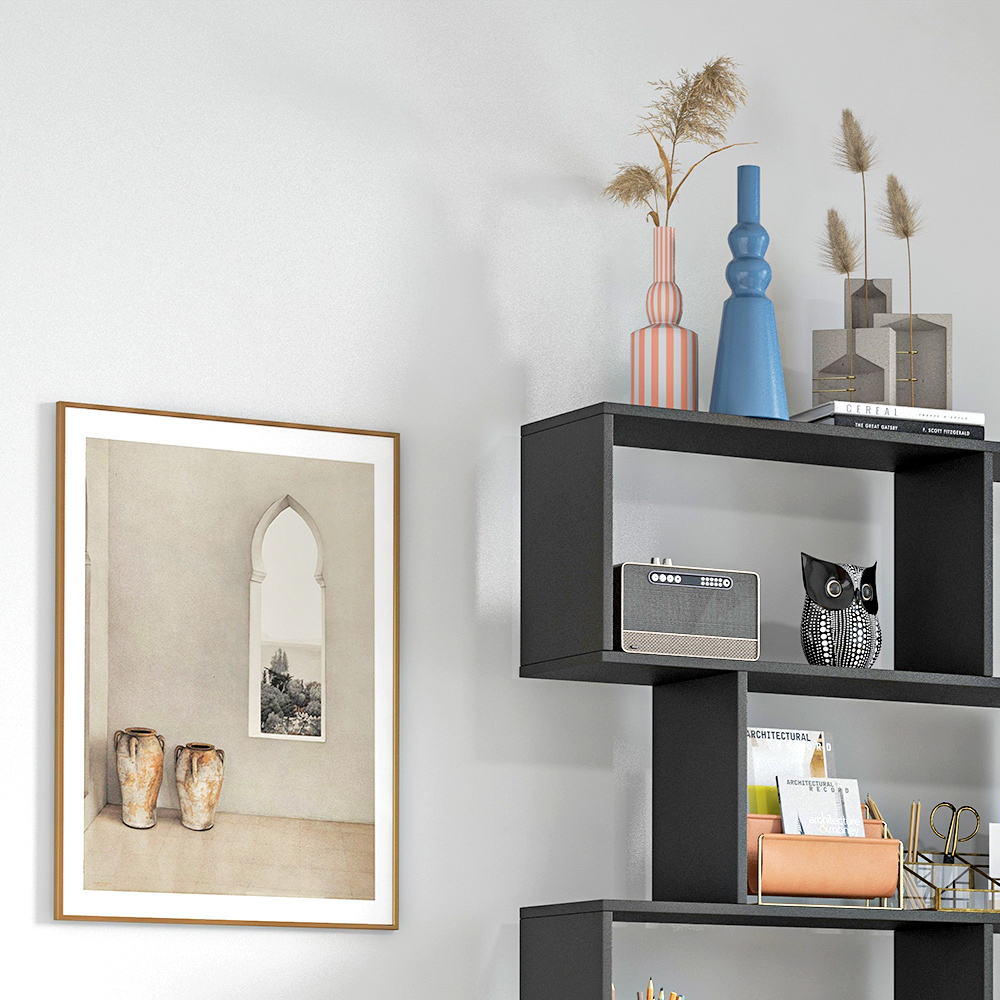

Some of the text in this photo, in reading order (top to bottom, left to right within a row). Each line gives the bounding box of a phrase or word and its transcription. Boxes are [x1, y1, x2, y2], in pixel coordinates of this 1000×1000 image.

[846, 404, 899, 417] CEREAL
[943, 429, 971, 437] FITZGERALD
[746, 730, 811, 742] ARCHITECTURAL
[786, 779, 834, 788] ARCHITECTURAL
[809, 786, 849, 794] RECORD
